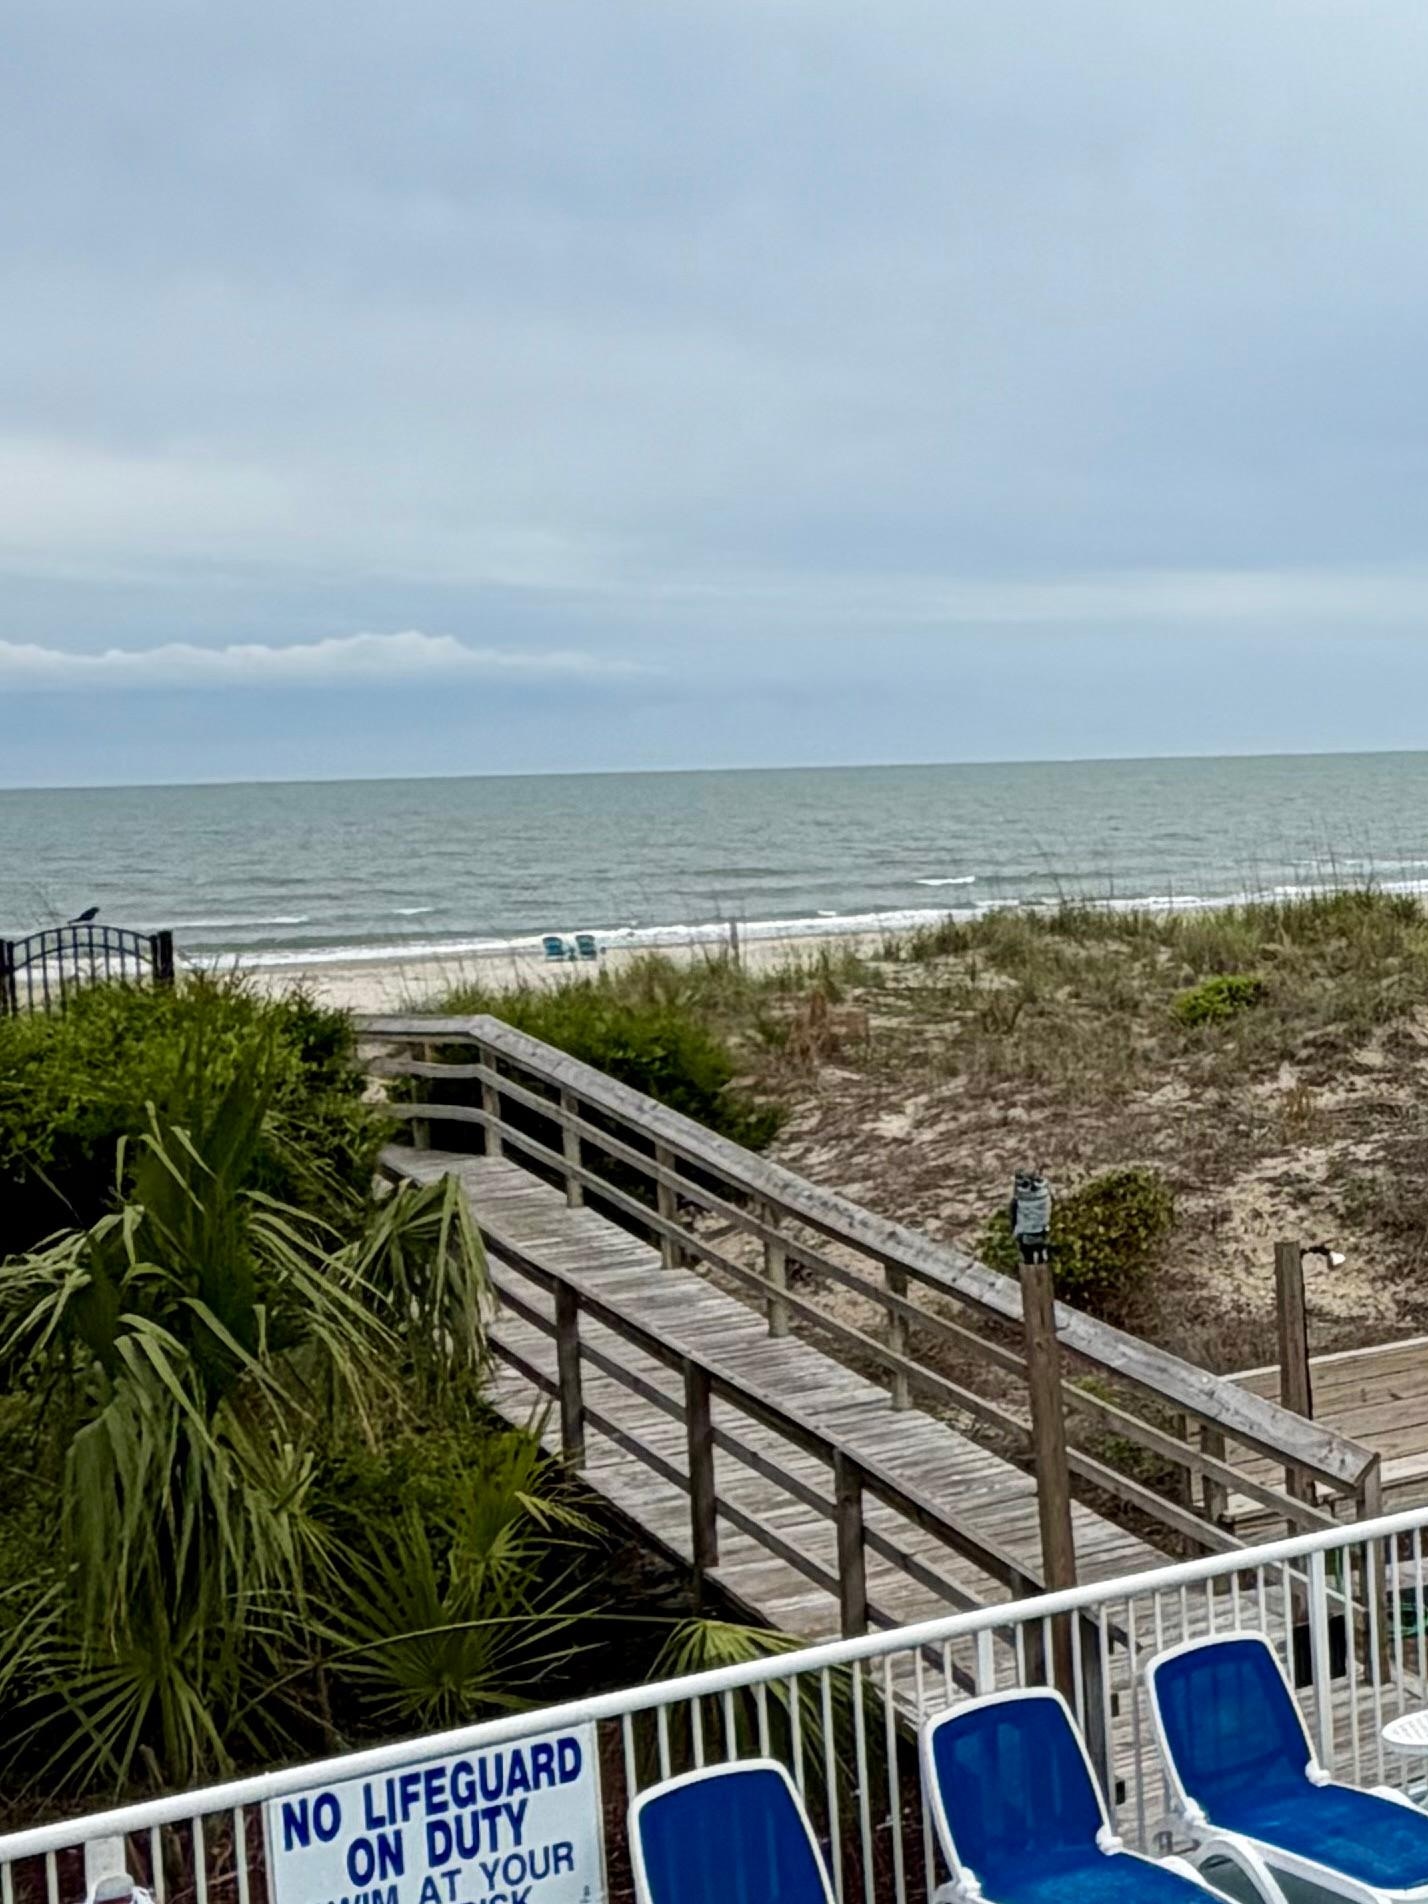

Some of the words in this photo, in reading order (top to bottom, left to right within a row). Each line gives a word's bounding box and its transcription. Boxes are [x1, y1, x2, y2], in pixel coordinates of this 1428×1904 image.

[282, 1792, 342, 1852] NO
[362, 1736, 582, 1831] LIFEGUARD
[346, 1828, 405, 1888] ON
[426, 1798, 529, 1868] DUTY
[479, 1841, 575, 1892] YOUR
